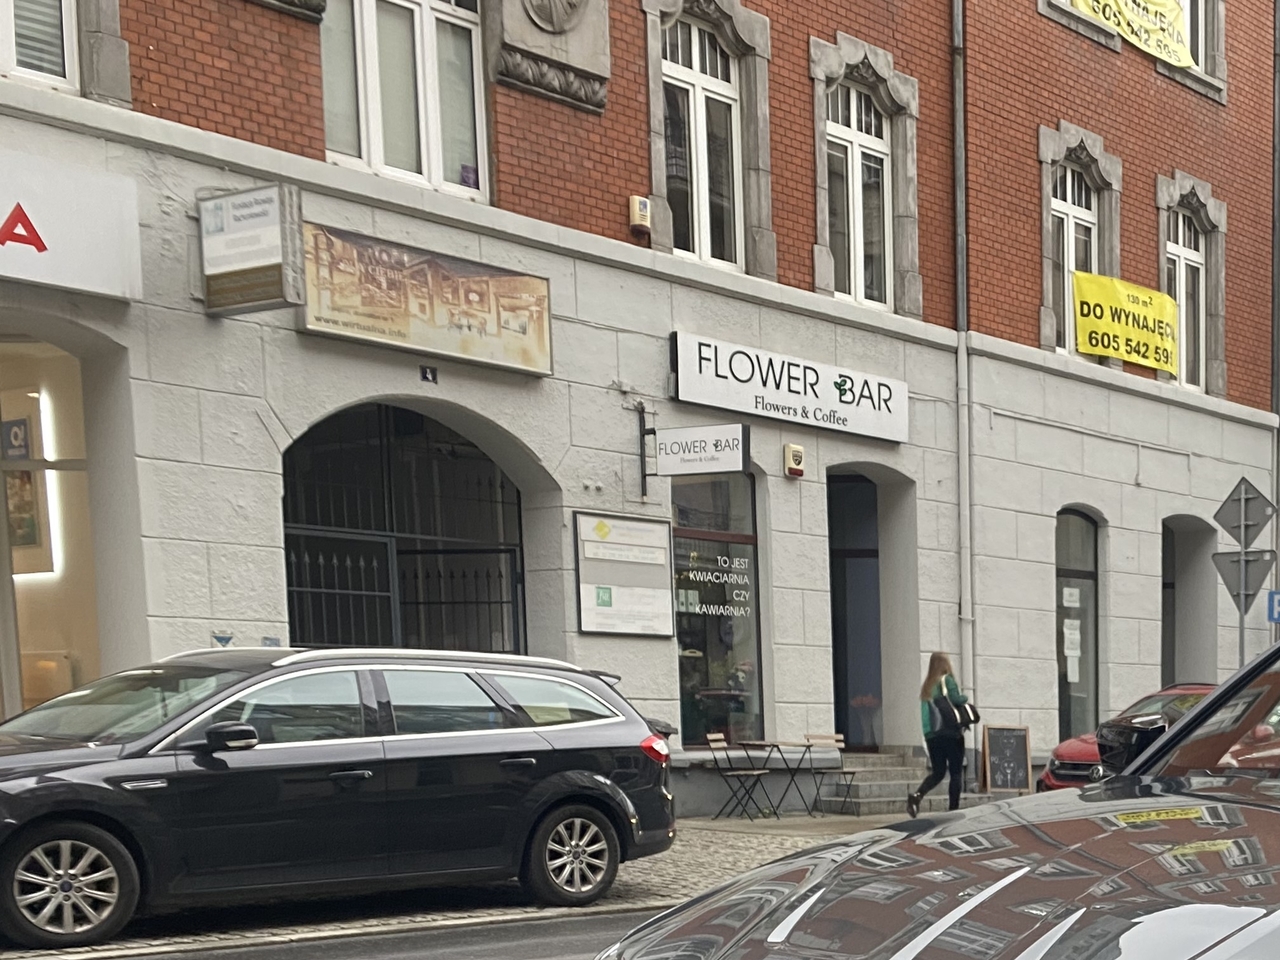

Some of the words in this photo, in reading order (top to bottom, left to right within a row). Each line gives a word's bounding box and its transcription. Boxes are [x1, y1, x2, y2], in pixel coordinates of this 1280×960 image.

[1126, 293, 1140, 305] 130
[1079, 300, 1104, 320] DO
[1088, 330, 1120, 351] 605
[1124, 337, 1150, 359] 542
[697, 341, 820, 399] FLOWER
[834, 373, 893, 414] BAR
[753, 395, 798, 416] Flowers
[800, 405, 810, 419] &
[813, 407, 848, 426] Coffee
[658, 439, 707, 456] FLOWER
[713, 437, 740, 453] BAR
[716, 555, 730, 568] TO
[731, 557, 749, 569] JEST
[689, 570, 750, 586] KWIACIARNIA
[732, 589, 750, 601] CZY
[695, 603, 751, 618] KAWIARNIA?
